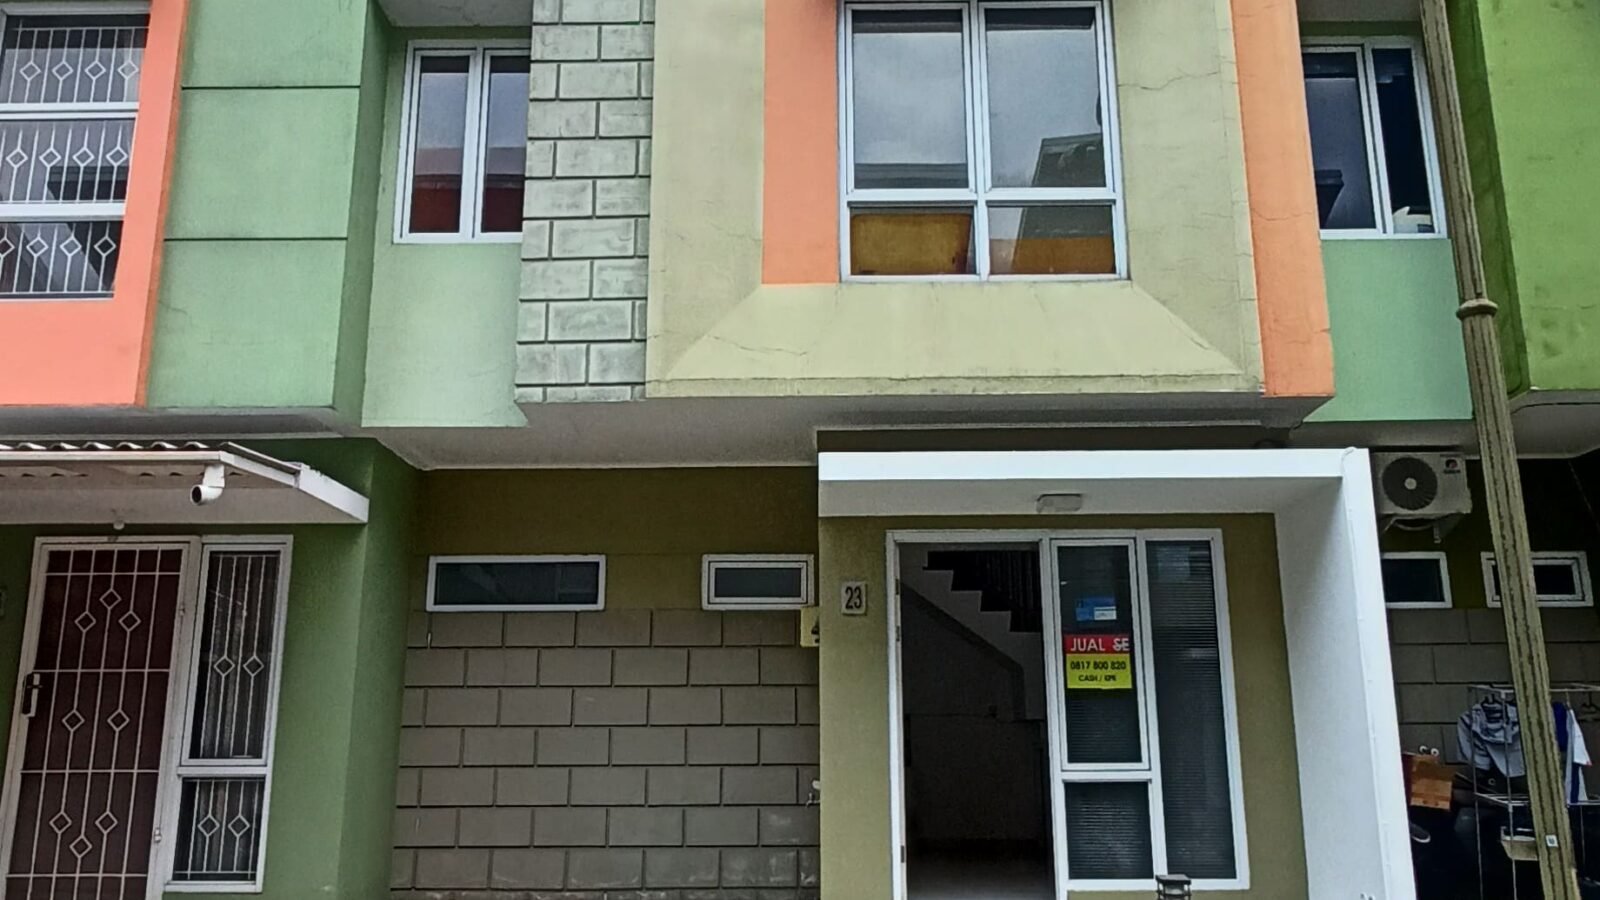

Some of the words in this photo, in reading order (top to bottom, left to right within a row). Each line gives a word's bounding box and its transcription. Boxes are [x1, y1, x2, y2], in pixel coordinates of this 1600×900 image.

[844, 586, 863, 609] 23
[1070, 637, 1106, 651] JUAL
[1070, 660, 1090, 670] 0817
